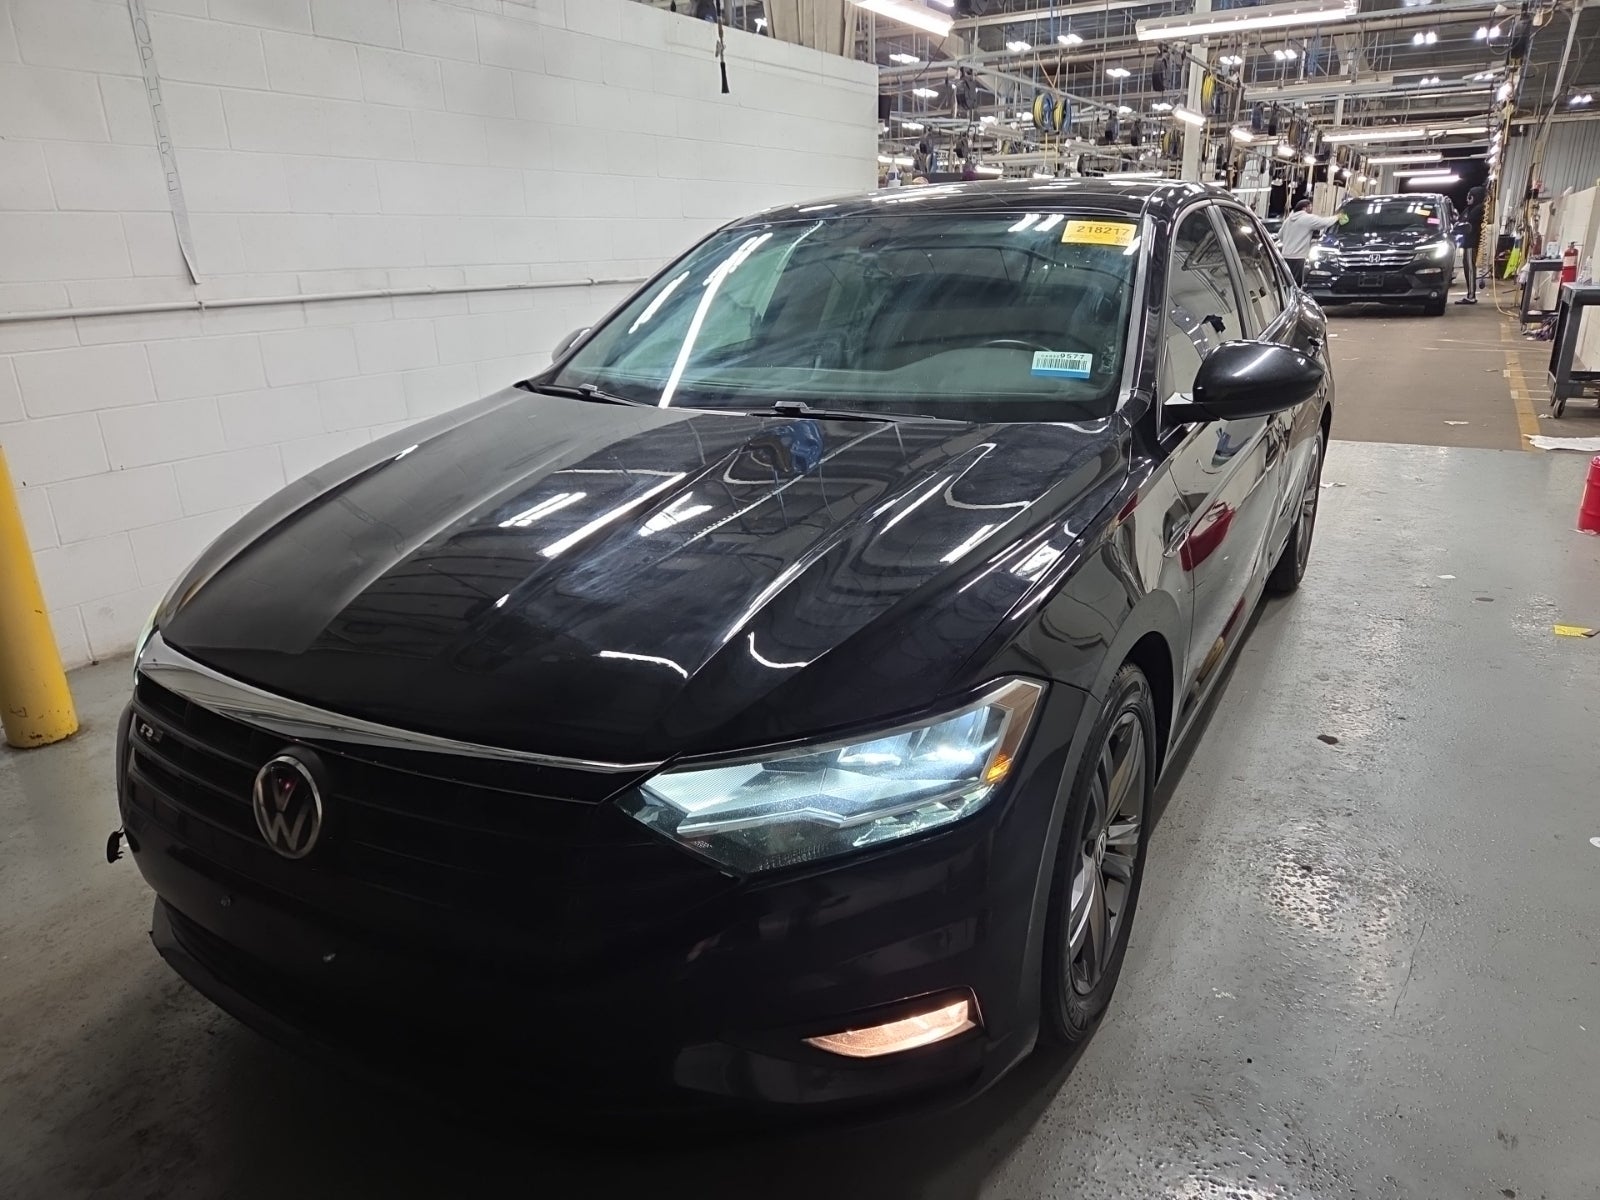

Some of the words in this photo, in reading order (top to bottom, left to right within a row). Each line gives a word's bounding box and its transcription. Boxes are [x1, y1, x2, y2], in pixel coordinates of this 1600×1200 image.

[146, 77, 178, 192] HERE
[1076, 225, 1130, 236] 218217
[1060, 352, 1085, 360] 9577
[254, 758, 321, 857] VW
